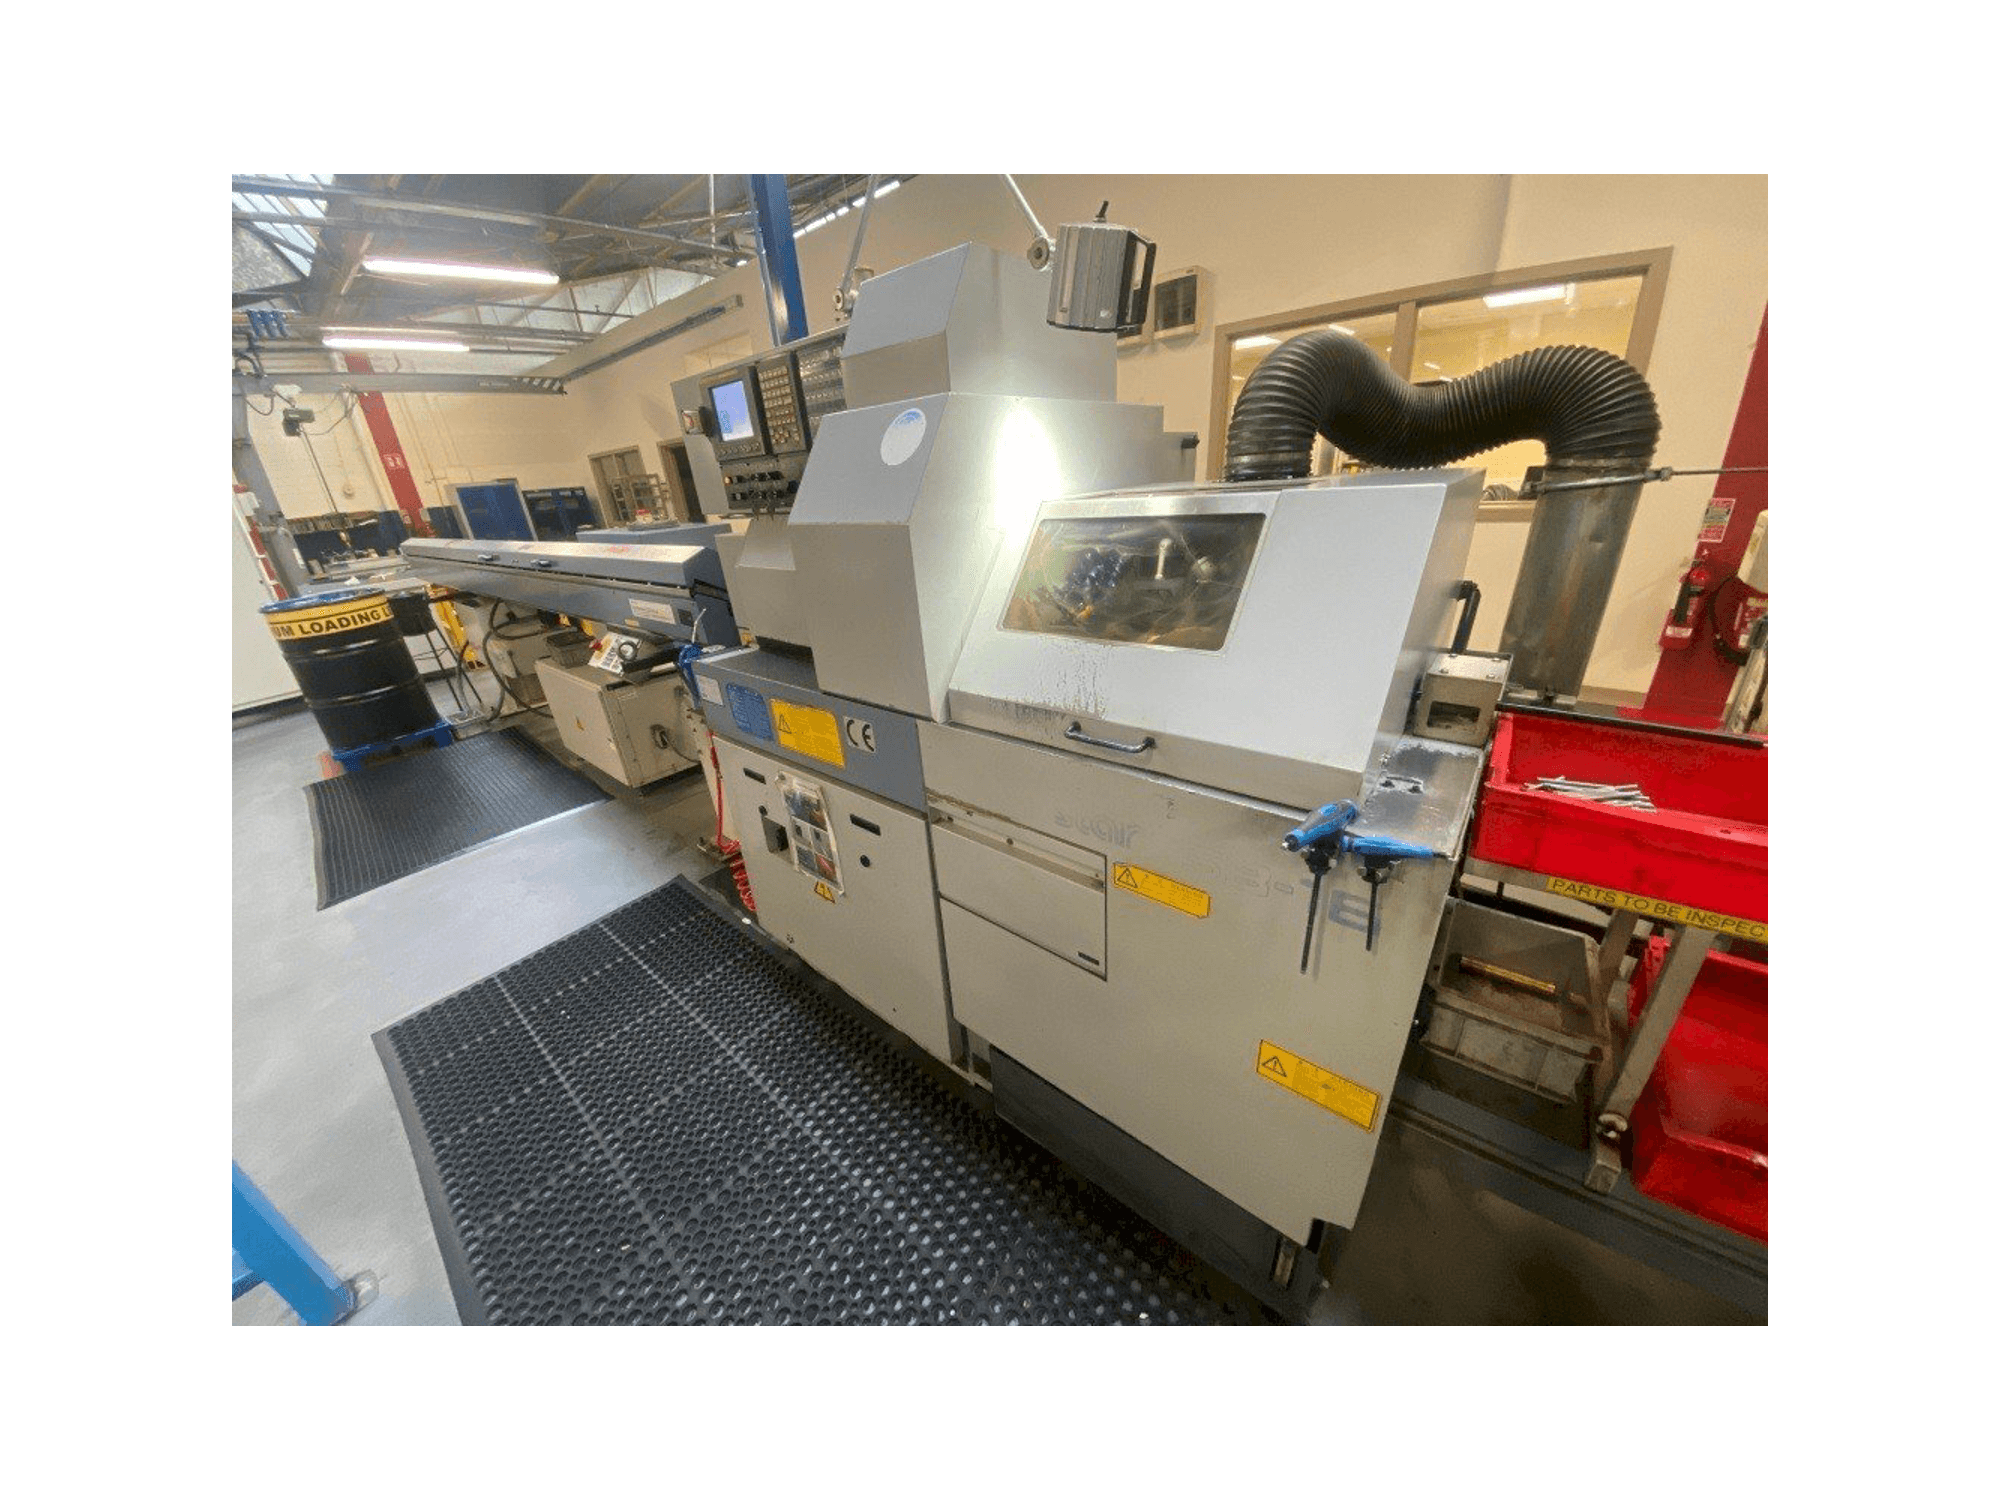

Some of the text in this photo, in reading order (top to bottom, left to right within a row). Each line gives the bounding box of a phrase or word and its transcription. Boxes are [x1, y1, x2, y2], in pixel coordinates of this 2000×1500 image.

[298, 610, 381, 635] LOADING
[1552, 879, 1616, 903] PARTS
[1621, 895, 1649, 911] TO
[1653, 902, 1682, 918] BE
